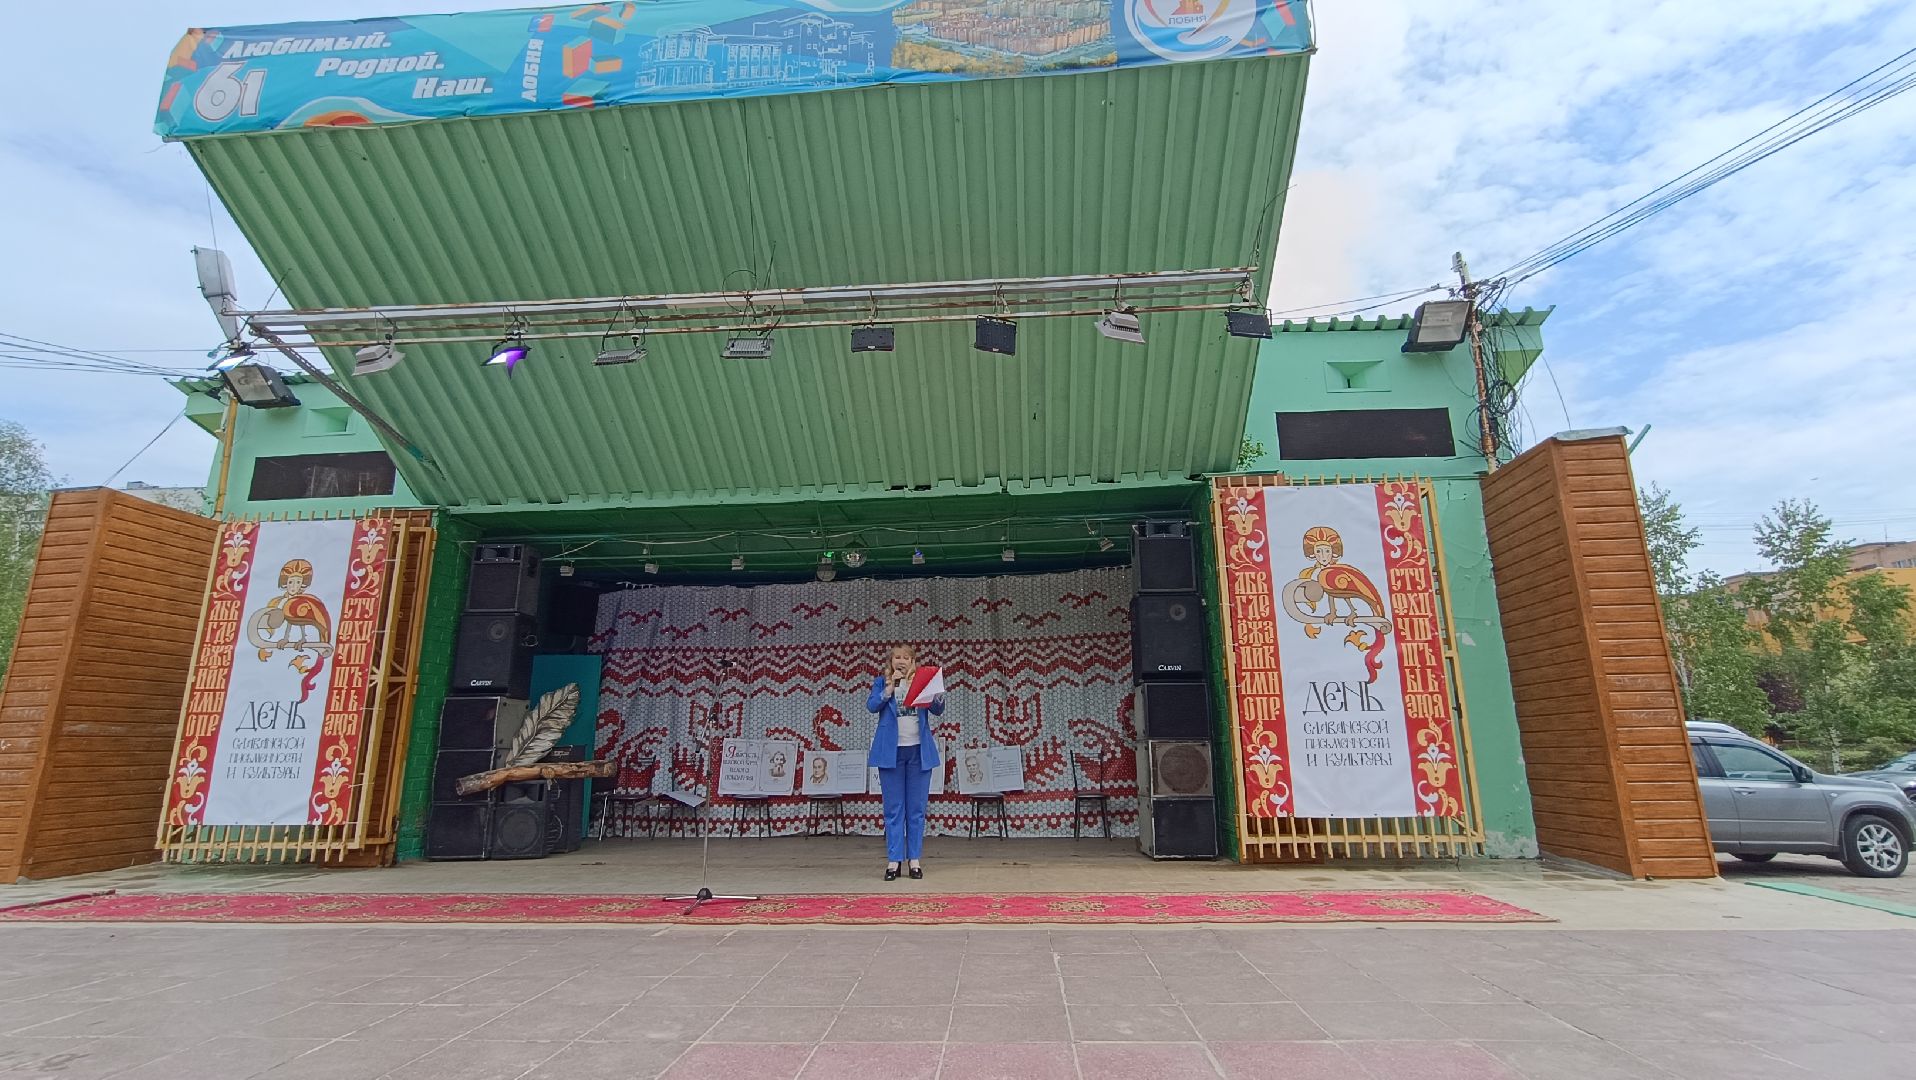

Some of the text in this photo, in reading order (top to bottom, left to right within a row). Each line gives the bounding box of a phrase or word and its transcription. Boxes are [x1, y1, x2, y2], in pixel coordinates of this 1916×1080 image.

[1168, 15, 1207, 25] ЛОБНЯ
[222, 32, 392, 59] Любимый.
[314, 51, 445, 78] Родной.
[521, 39, 544, 102] ЛОБНЯ
[193, 61, 267, 122] 61
[412, 77, 493, 99] Наш.
[1302, 681, 1386, 716] ДЕНЬ
[235, 701, 306, 732] ДЕНЬ
[1303, 718, 1389, 734] СЛАВЯНСКОЙ
[226, 766, 237, 779] И
[1306, 752, 1393, 767] И КУЛЬТУРЫ
